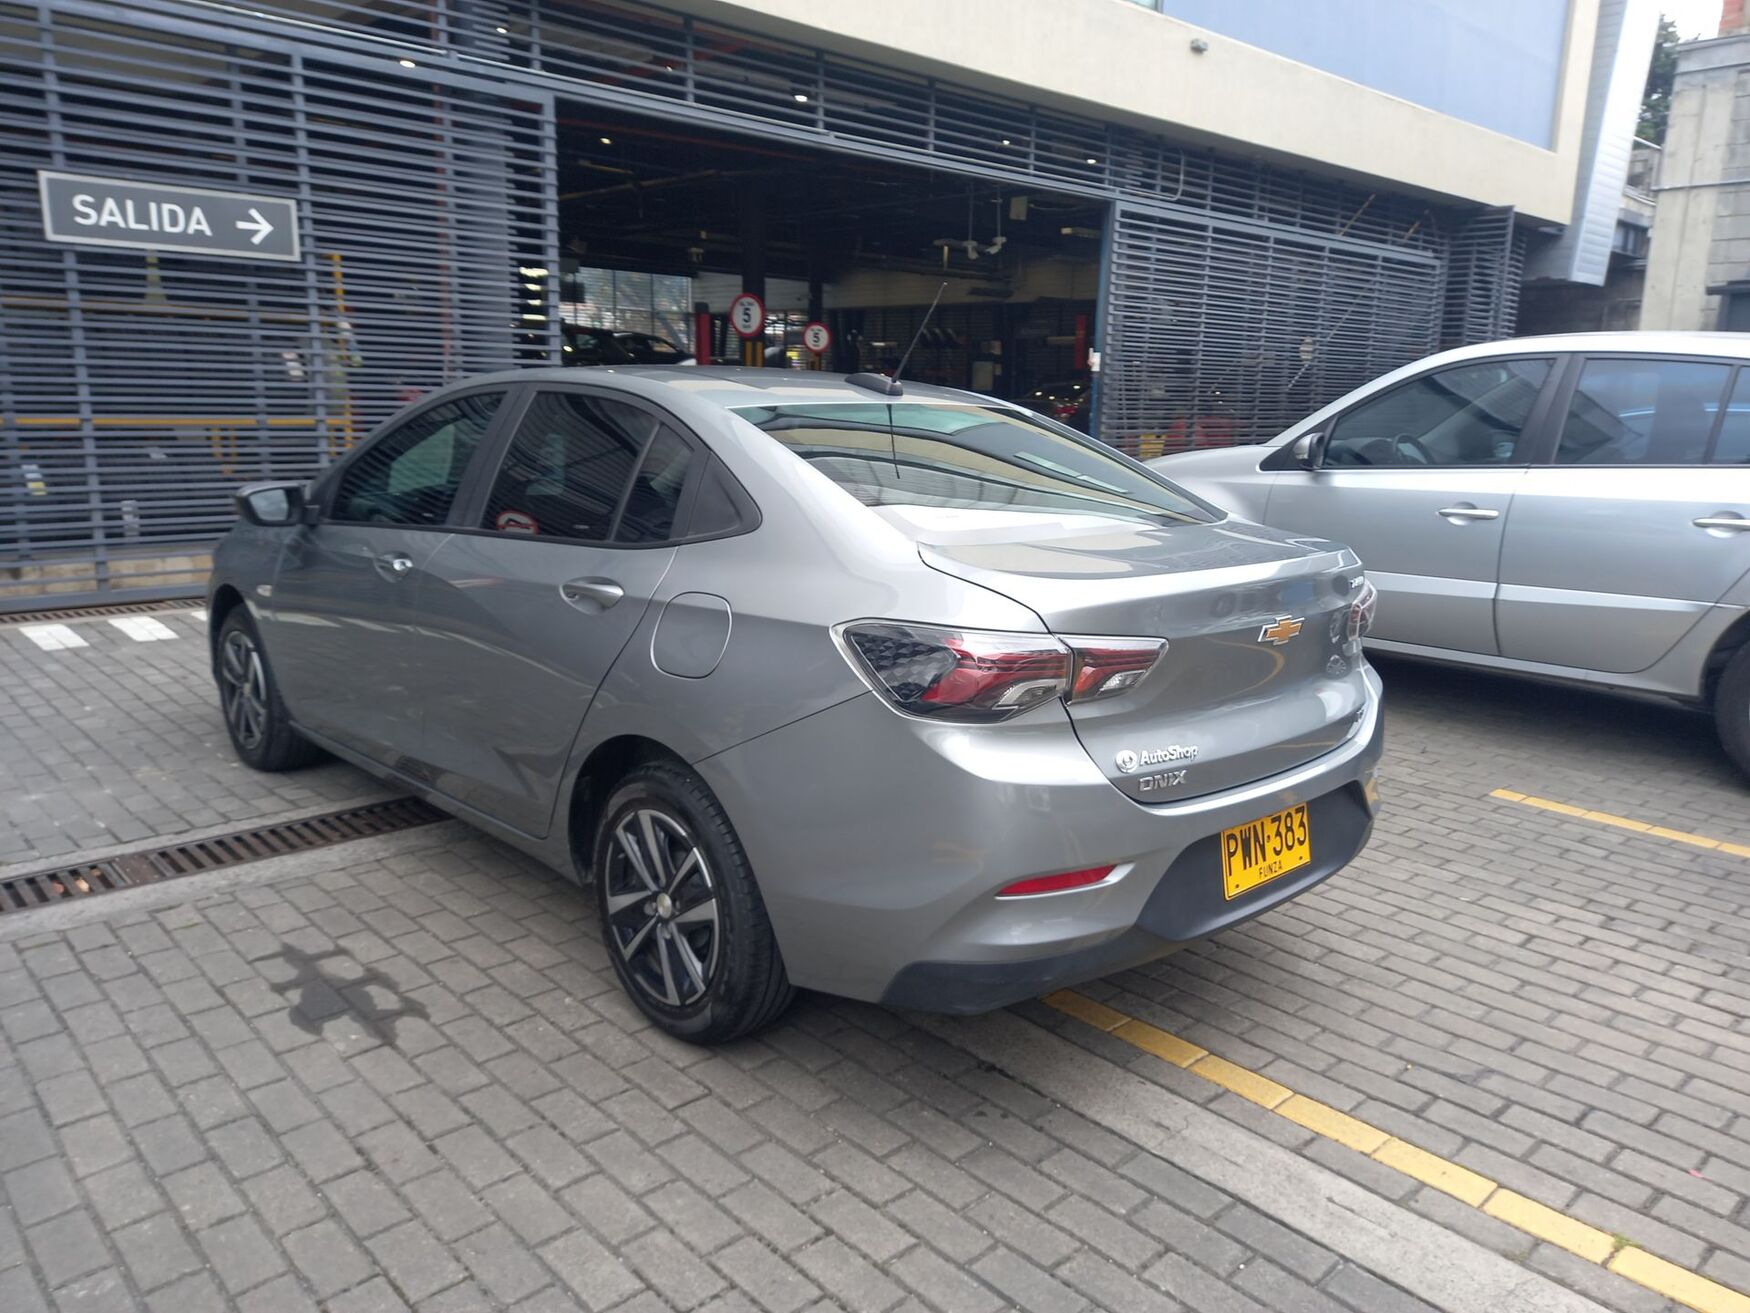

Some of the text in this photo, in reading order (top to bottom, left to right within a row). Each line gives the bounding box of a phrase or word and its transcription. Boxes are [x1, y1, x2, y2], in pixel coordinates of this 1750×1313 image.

[72, 194, 213, 237] SALIDA
[742, 307, 752, 323] 5
[813, 332, 821, 344] 5
[1140, 744, 1199, 766] AutoShop
[1139, 769, 1188, 792] ONIX
[1258, 860, 1283, 879] FUNZA
